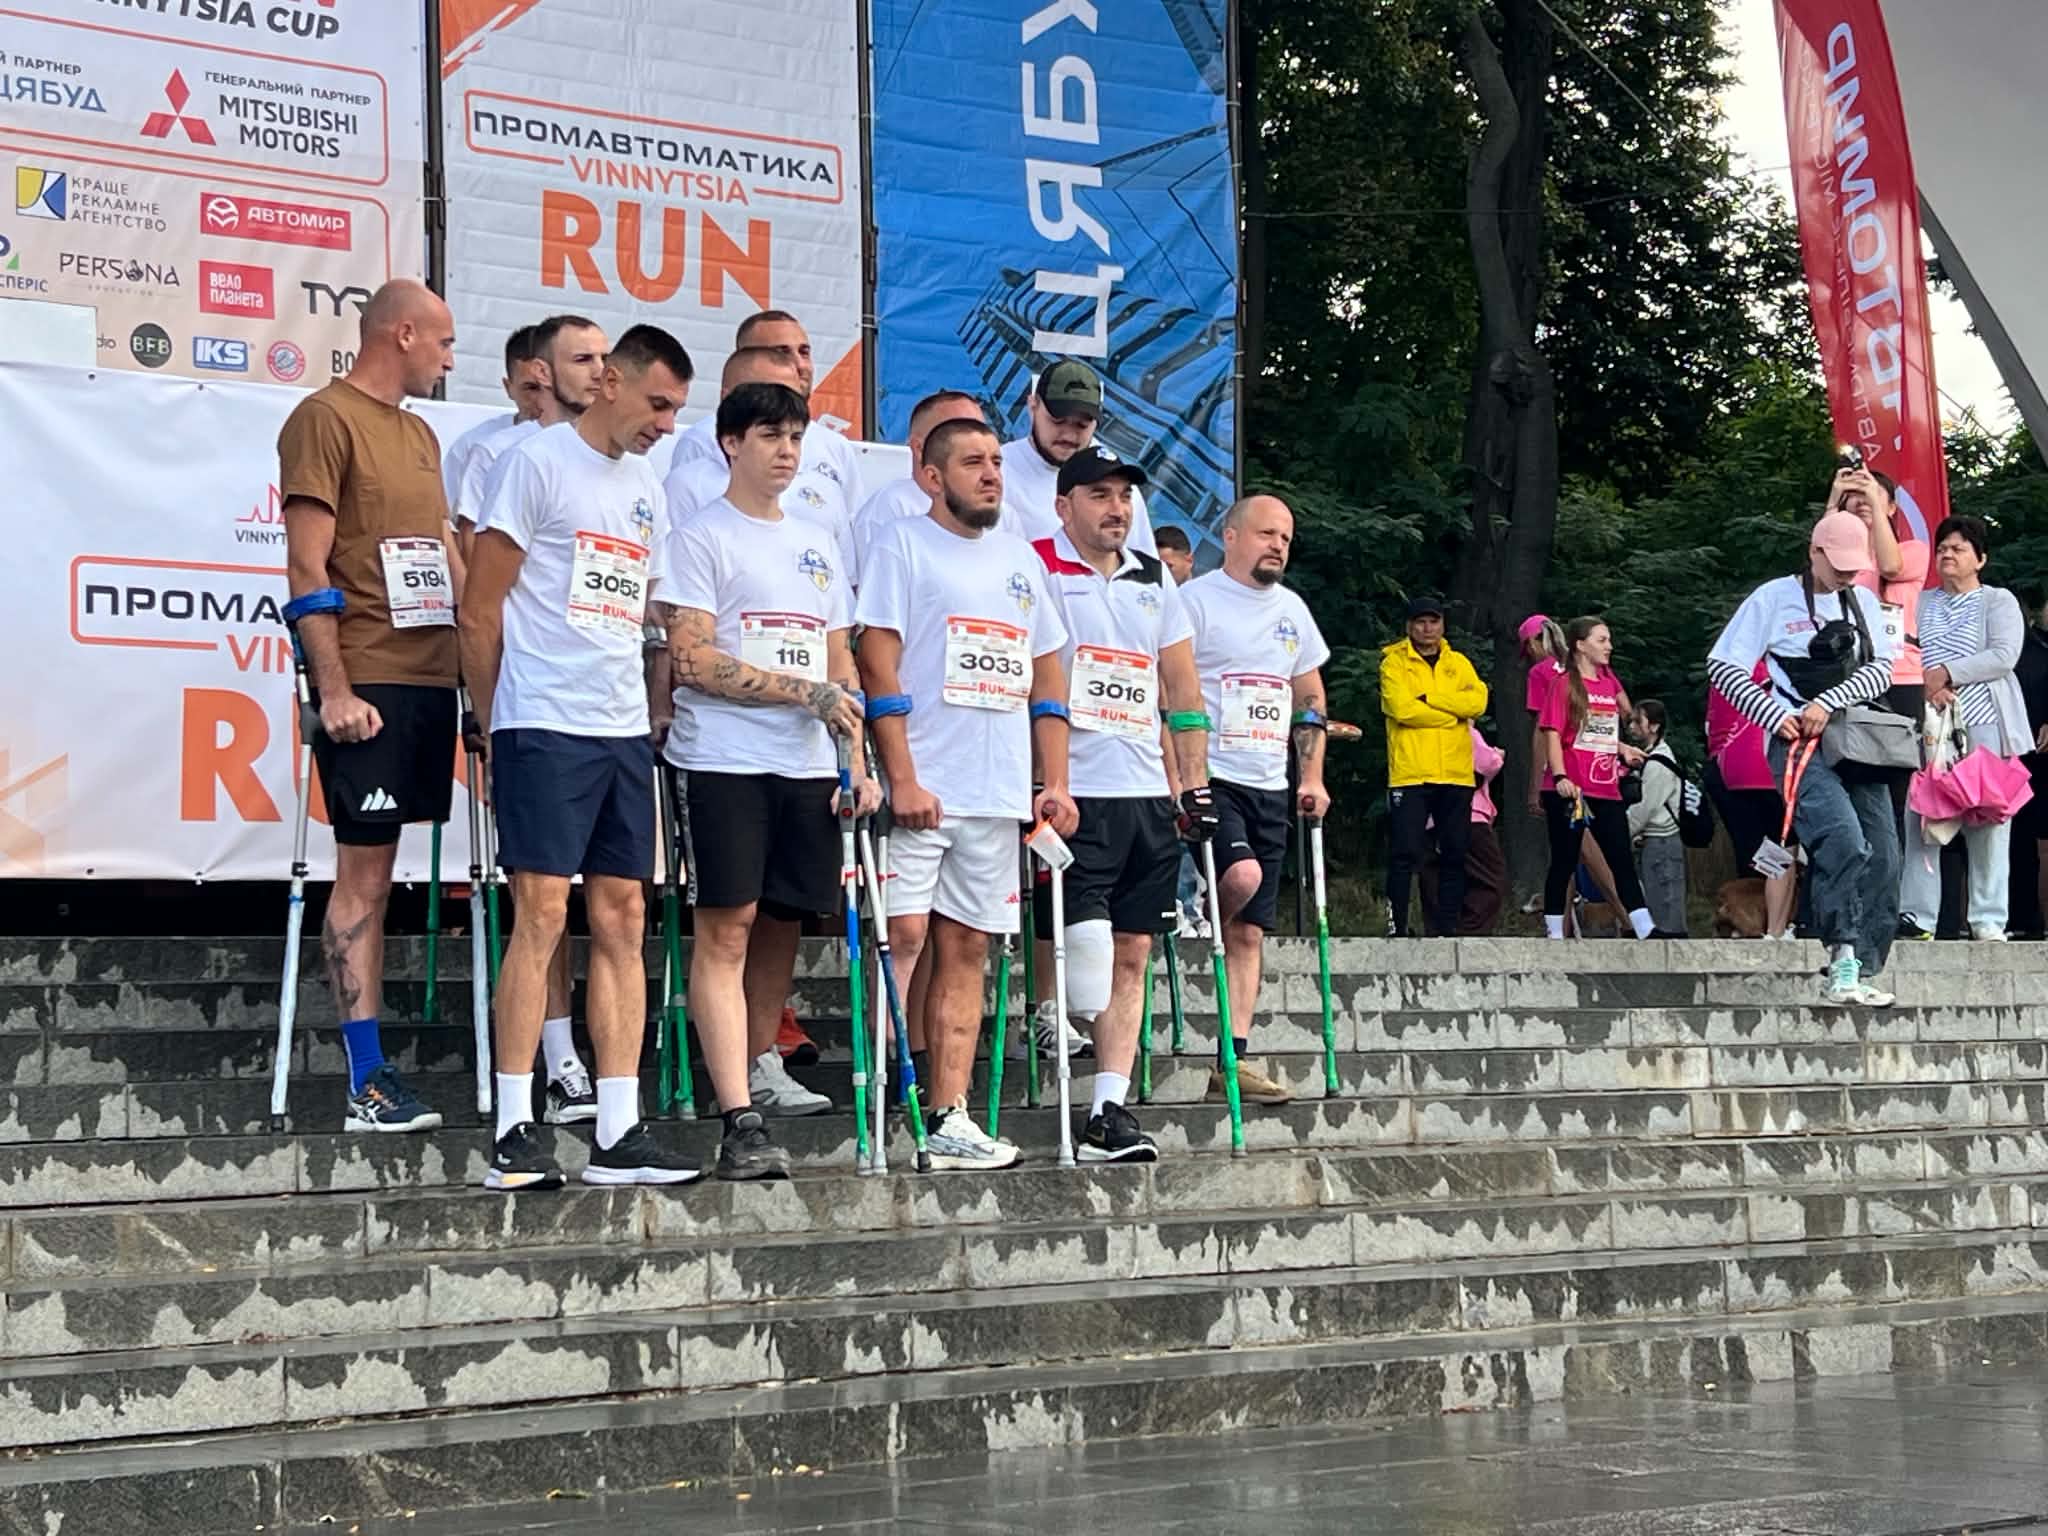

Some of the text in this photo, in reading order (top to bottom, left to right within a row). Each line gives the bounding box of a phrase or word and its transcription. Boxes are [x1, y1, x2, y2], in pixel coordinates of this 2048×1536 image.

[267, 7, 339, 38] CUP
[14, 55, 81, 75] ПАРТНЕР
[205, 71, 371, 106] ГЕНЕРАЛЬНИЙ ПАРТНЕР
[219, 94, 358, 135] MITSUBISHI
[240, 124, 340, 158] MOTORS
[473, 109, 833, 185] ПРОМАВТОМАТИКА
[72, 176, 129, 196] КРАЩЕ
[570, 154, 749, 206] VINNYTSIA
[72, 193, 160, 215] РЕКЛАМНЕ
[1021, 0, 1125, 402] ЦЯБУ
[72, 210, 167, 232] АГЕНТСТВО
[247, 206, 345, 231] АВТОМИР
[541, 189, 771, 311] RUN
[59, 253, 180, 287] PERSONA
[132, 335, 169, 354] BFB
[196, 338, 245, 366] IKS
[584, 571, 640, 600] 3052
[776, 648, 810, 667] 118
[960, 652, 1023, 677] 3033
[1088, 680, 1146, 704] 3016
[1248, 705, 1281, 721] 160
